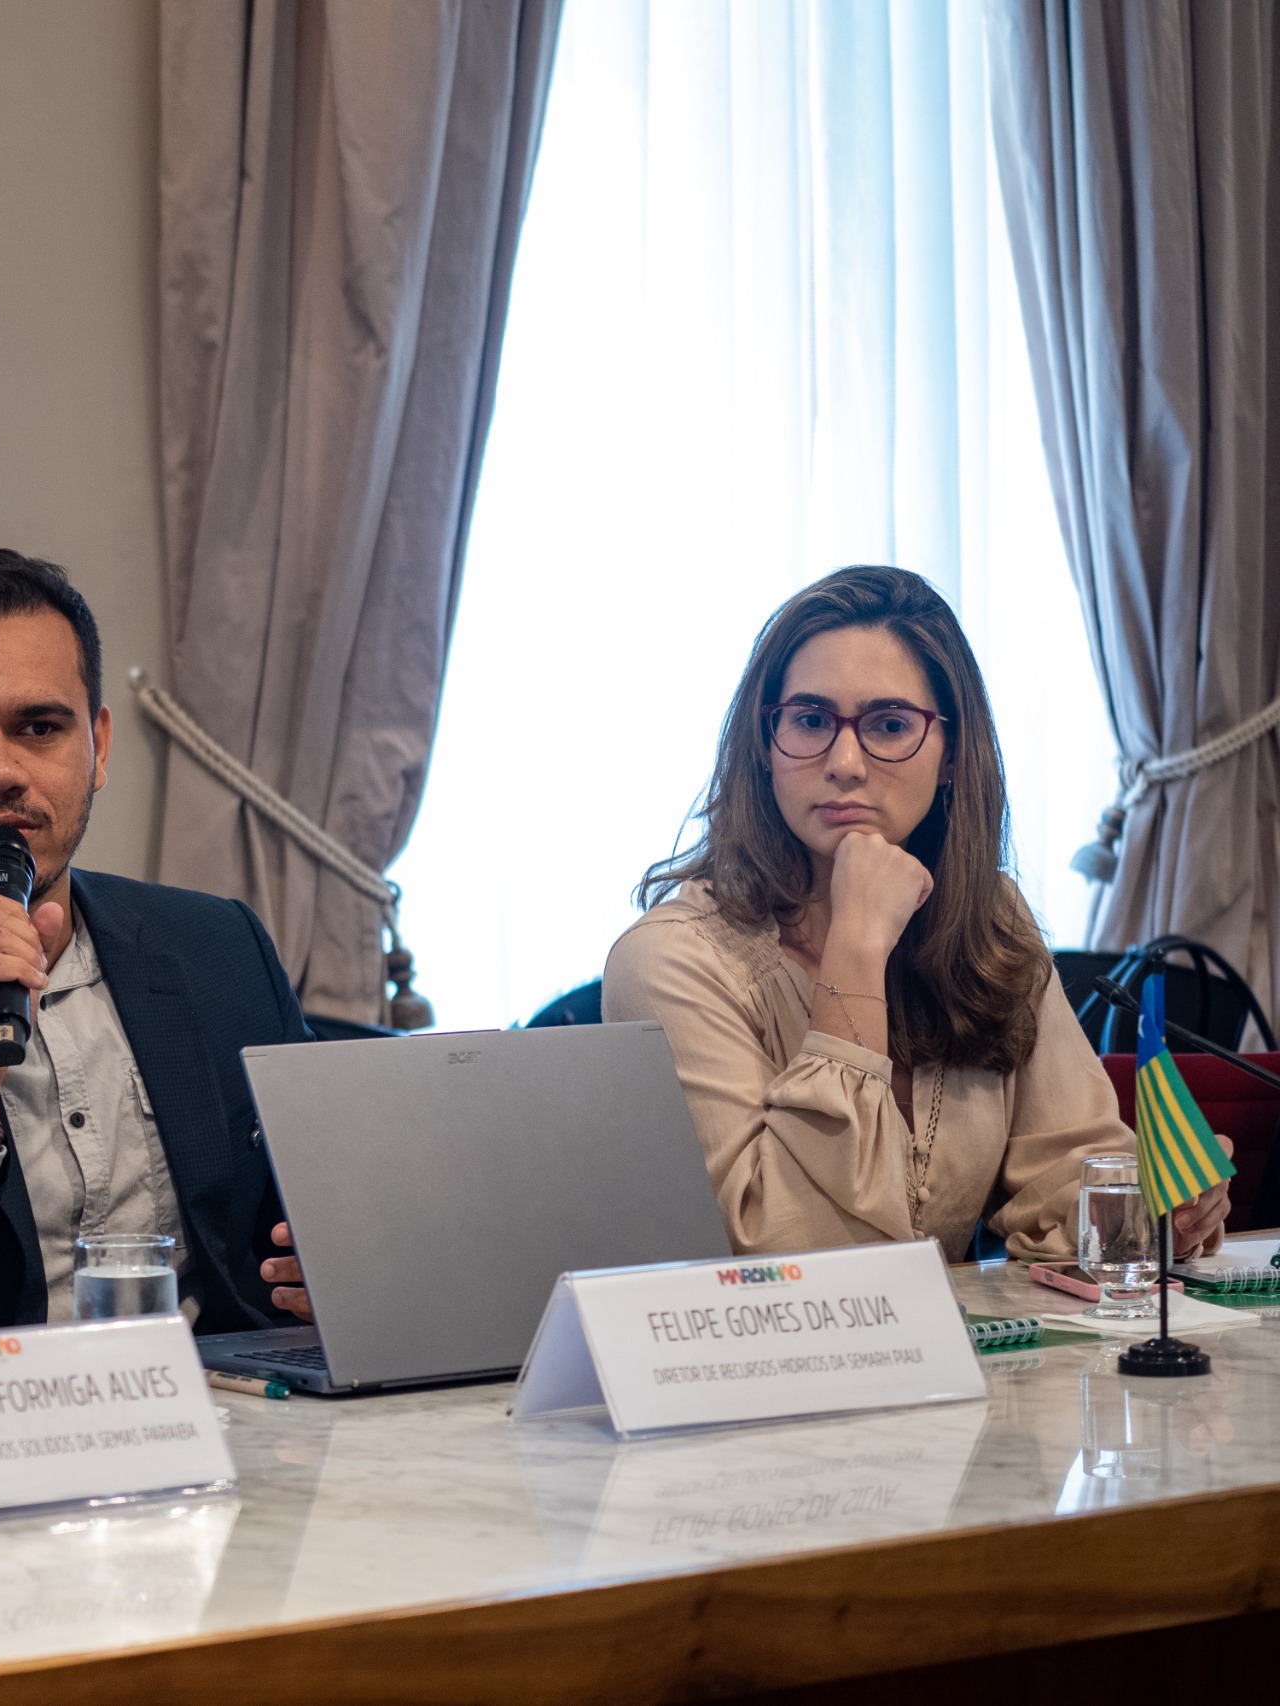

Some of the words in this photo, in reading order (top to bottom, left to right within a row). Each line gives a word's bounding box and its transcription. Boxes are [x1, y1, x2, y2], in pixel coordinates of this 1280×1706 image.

[448, 1051, 481, 1064] acer
[647, 1307, 723, 1343] FELIPE
[724, 1301, 803, 1337] GOMES
[803, 1300, 839, 1331] DA
[839, 1295, 900, 1328] SILVA
[107, 1364, 179, 1402] ALVES
[652, 1365, 701, 1386] DIRETOR
[701, 1364, 720, 1381] DE
[719, 1360, 779, 1380] RECURSOS
[828, 1354, 846, 1371] DA
[846, 1350, 893, 1370] SEMARH
[75, 1430, 98, 1452] DA
[96, 1426, 144, 1450] SEMAS
